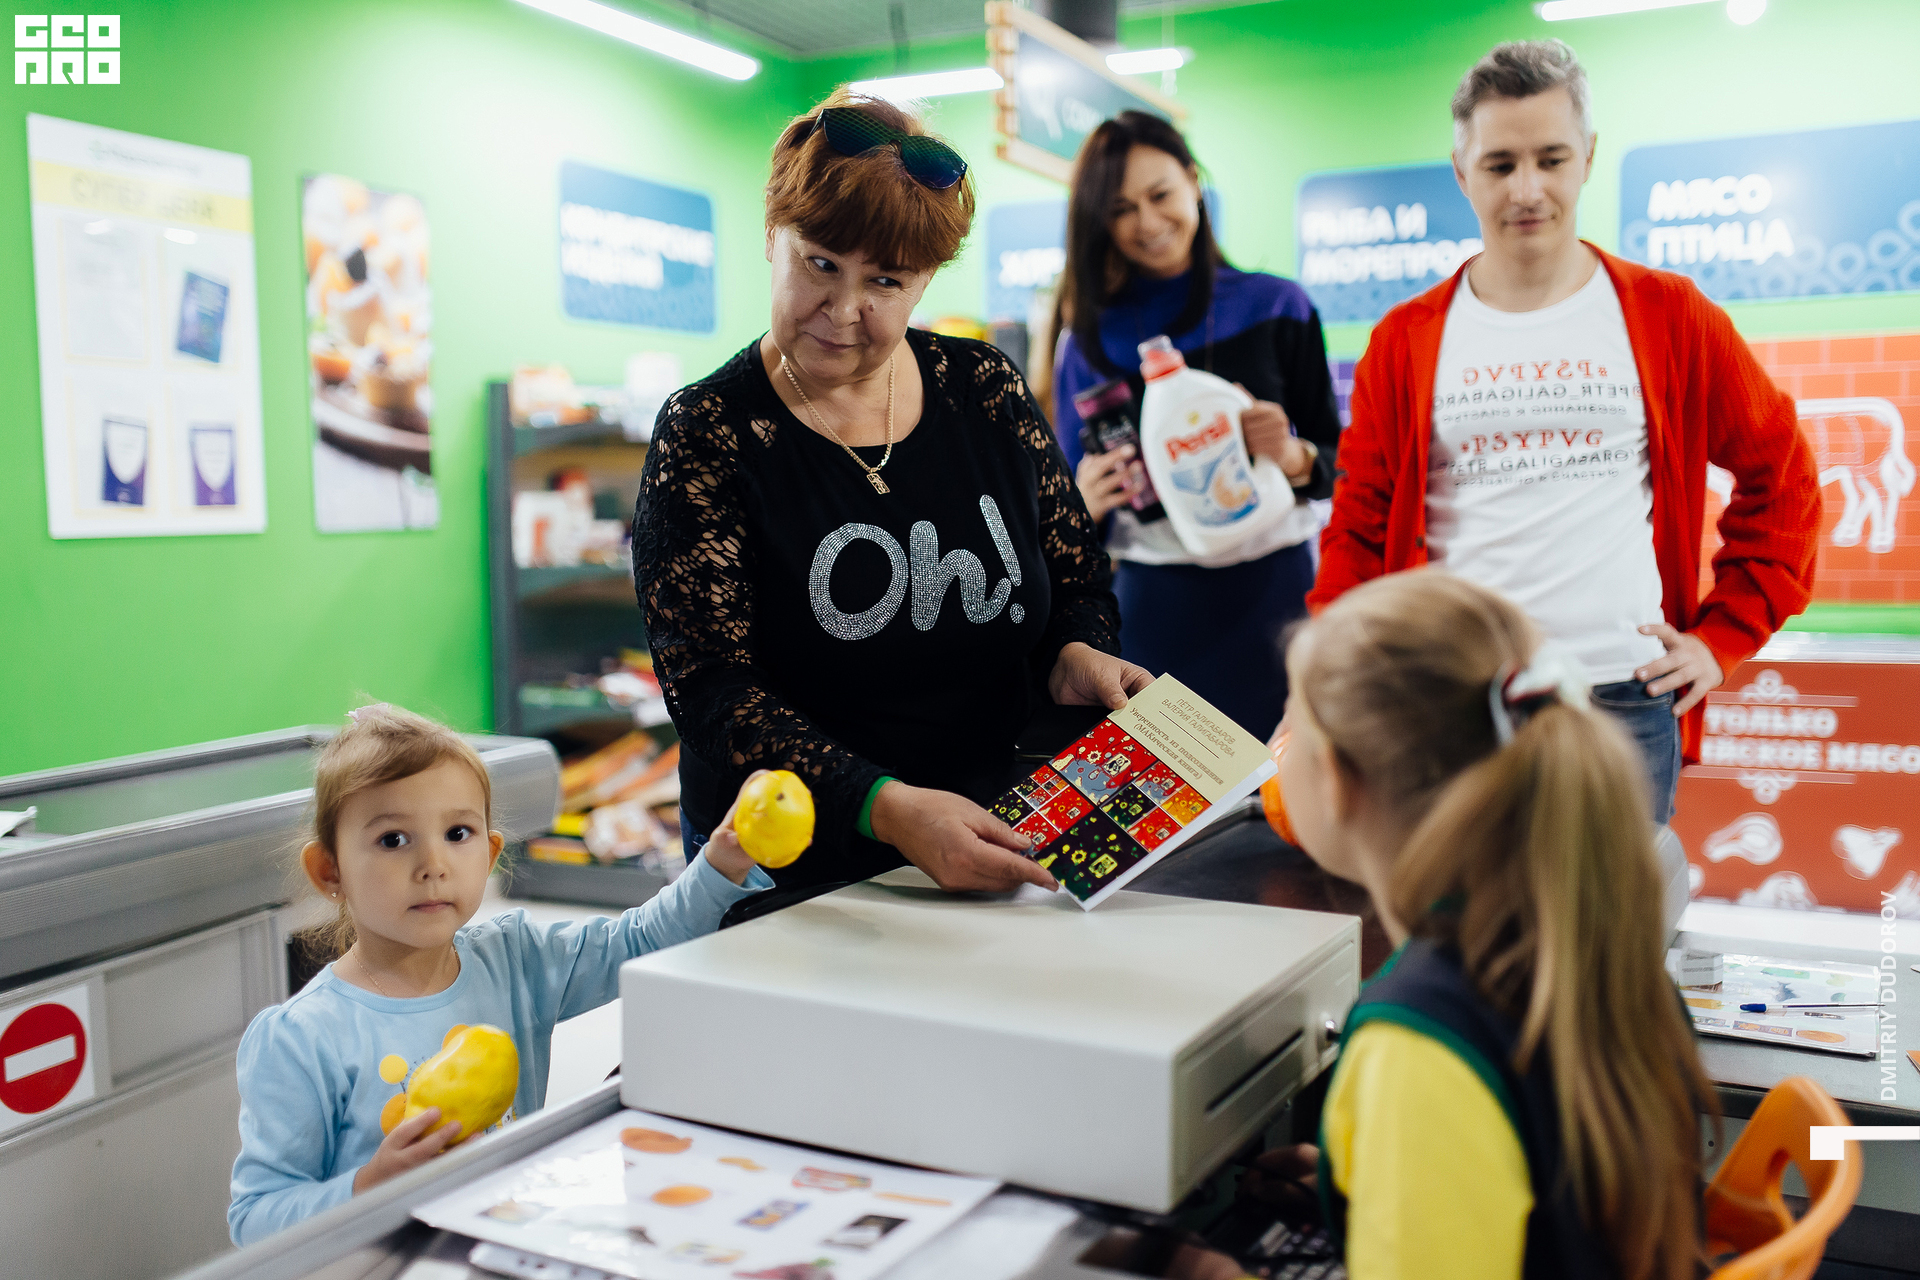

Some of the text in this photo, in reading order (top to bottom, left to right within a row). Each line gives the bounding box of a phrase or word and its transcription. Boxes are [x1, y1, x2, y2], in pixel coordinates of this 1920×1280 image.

[1648, 174, 1772, 222] МЯСО
[1648, 218, 1795, 266] ПТИЦА
[809, 494, 1025, 641] Oh!
[1130, 707, 1170, 742] Уверенность
[1704, 704, 1839, 738] ТОЛЬКО
